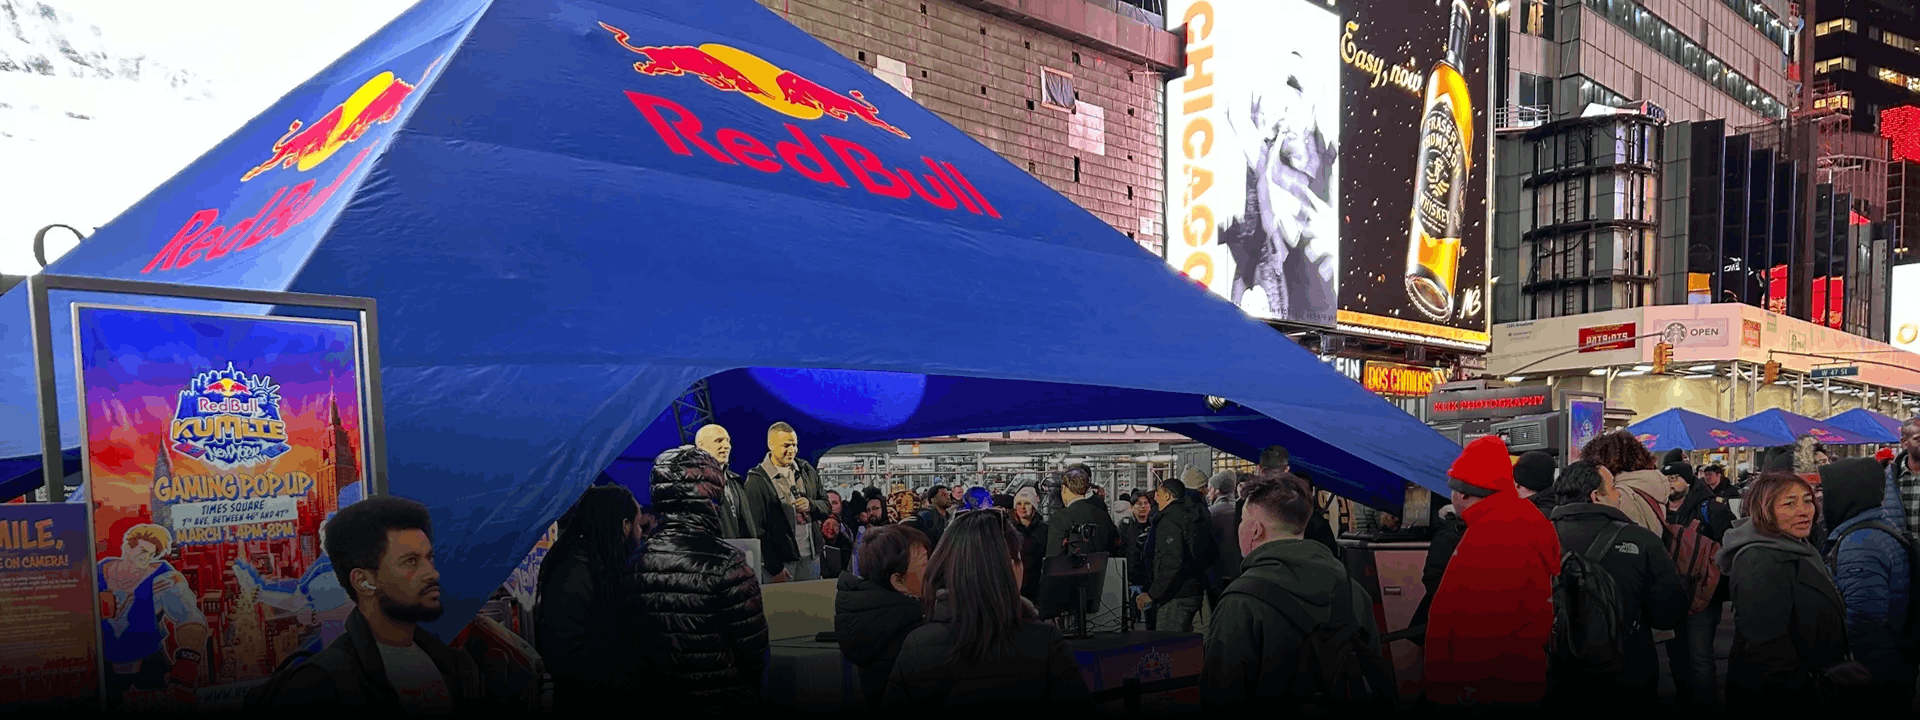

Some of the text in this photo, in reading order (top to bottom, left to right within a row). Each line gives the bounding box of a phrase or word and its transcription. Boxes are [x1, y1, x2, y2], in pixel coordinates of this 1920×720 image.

[1340, 20, 1423, 92] Easy, now
[1427, 115, 1457, 147] FRASER
[622, 89, 1002, 219] Red Bull
[1419, 190, 1451, 224] WHISKEY
[139, 185, 290, 274] Red
[1690, 328, 1719, 337] OPEN
[1368, 366, 1433, 393] DOS CAMINOS
[199, 397, 258, 413] Red Bull
[1460, 395, 1545, 410] PHOTOGRAPHY
[154, 471, 313, 503] GAMING POP UP
[202, 500, 265, 515] TIMES SQUARE
[212, 514, 243, 524] BETWEEN
[260, 511, 274, 519] AND
[176, 526, 221, 545] MARCH
[236, 521, 296, 540] 4PM-8PM
[4, 556, 20, 569] ON
[21, 553, 69, 568] CAMERA!
